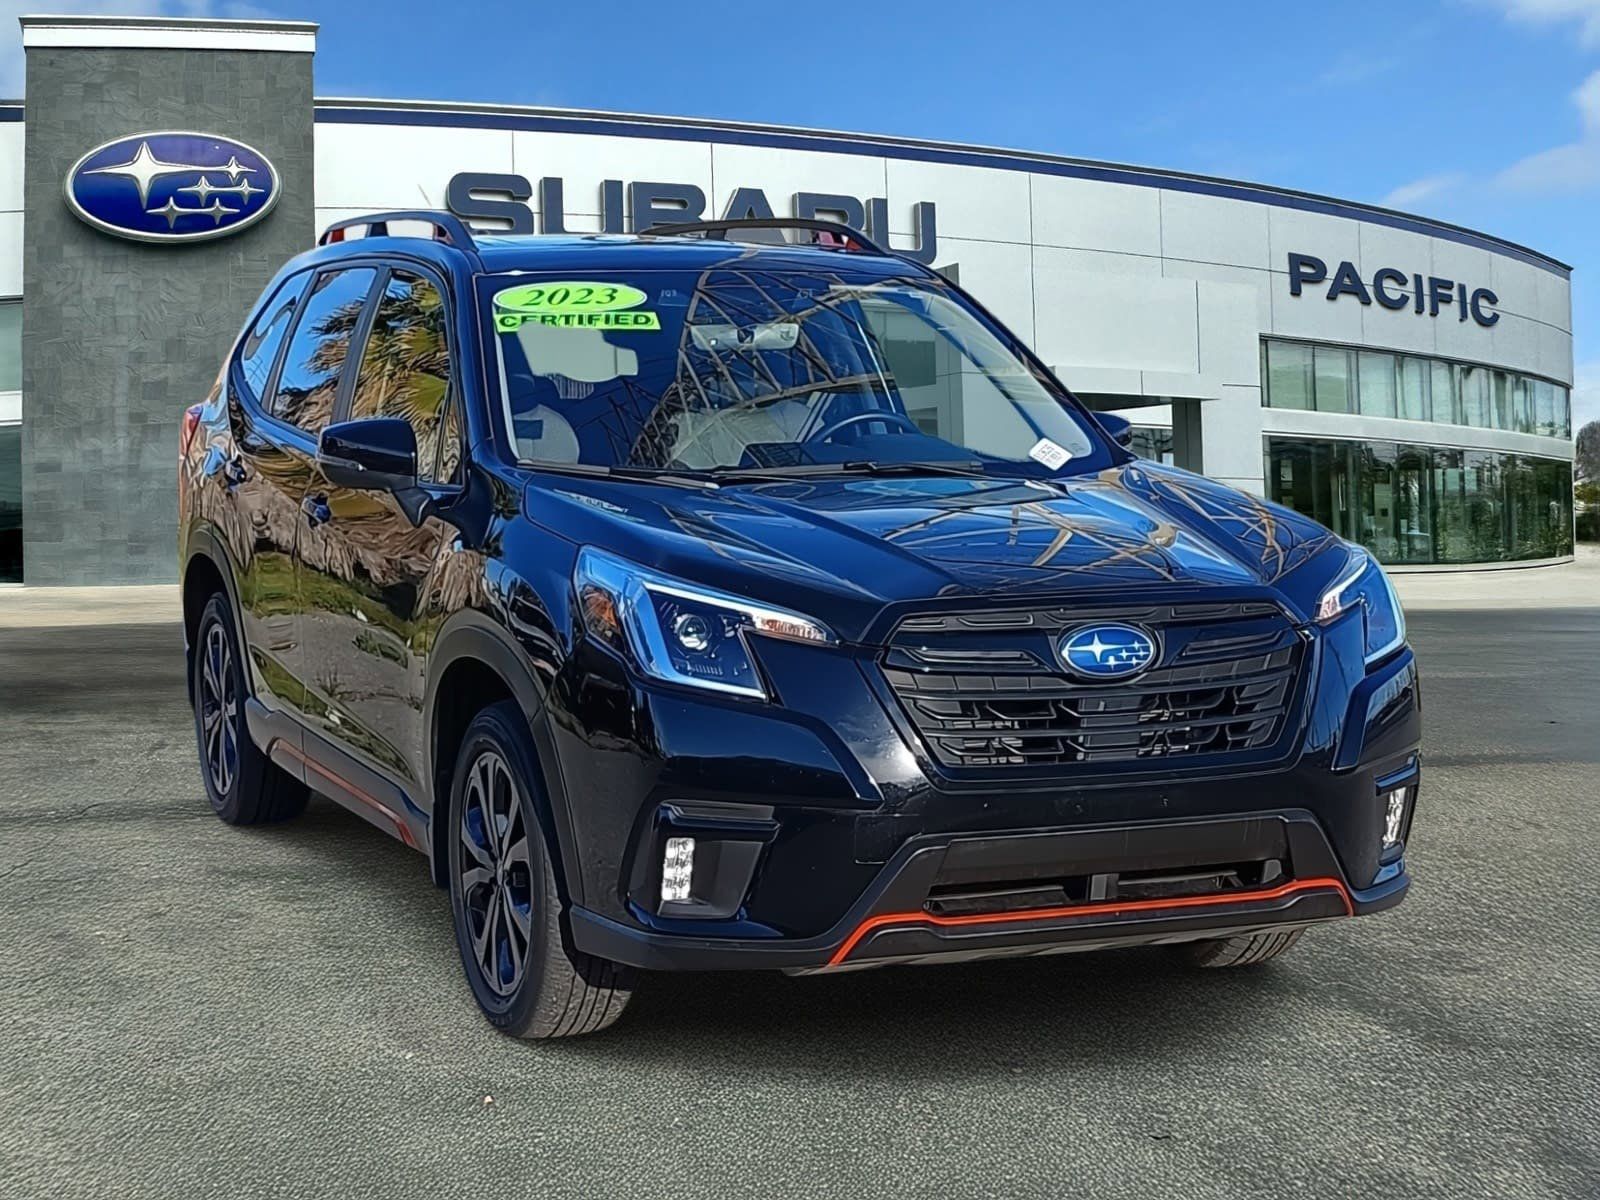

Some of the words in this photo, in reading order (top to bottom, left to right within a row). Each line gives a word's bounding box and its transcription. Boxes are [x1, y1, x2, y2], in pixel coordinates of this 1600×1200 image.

[446, 172, 937, 264] SUBARU
[521, 288, 619, 306] 2023
[1288, 252, 1500, 327] PACIFIC
[499, 314, 653, 328] CERTIFIED
